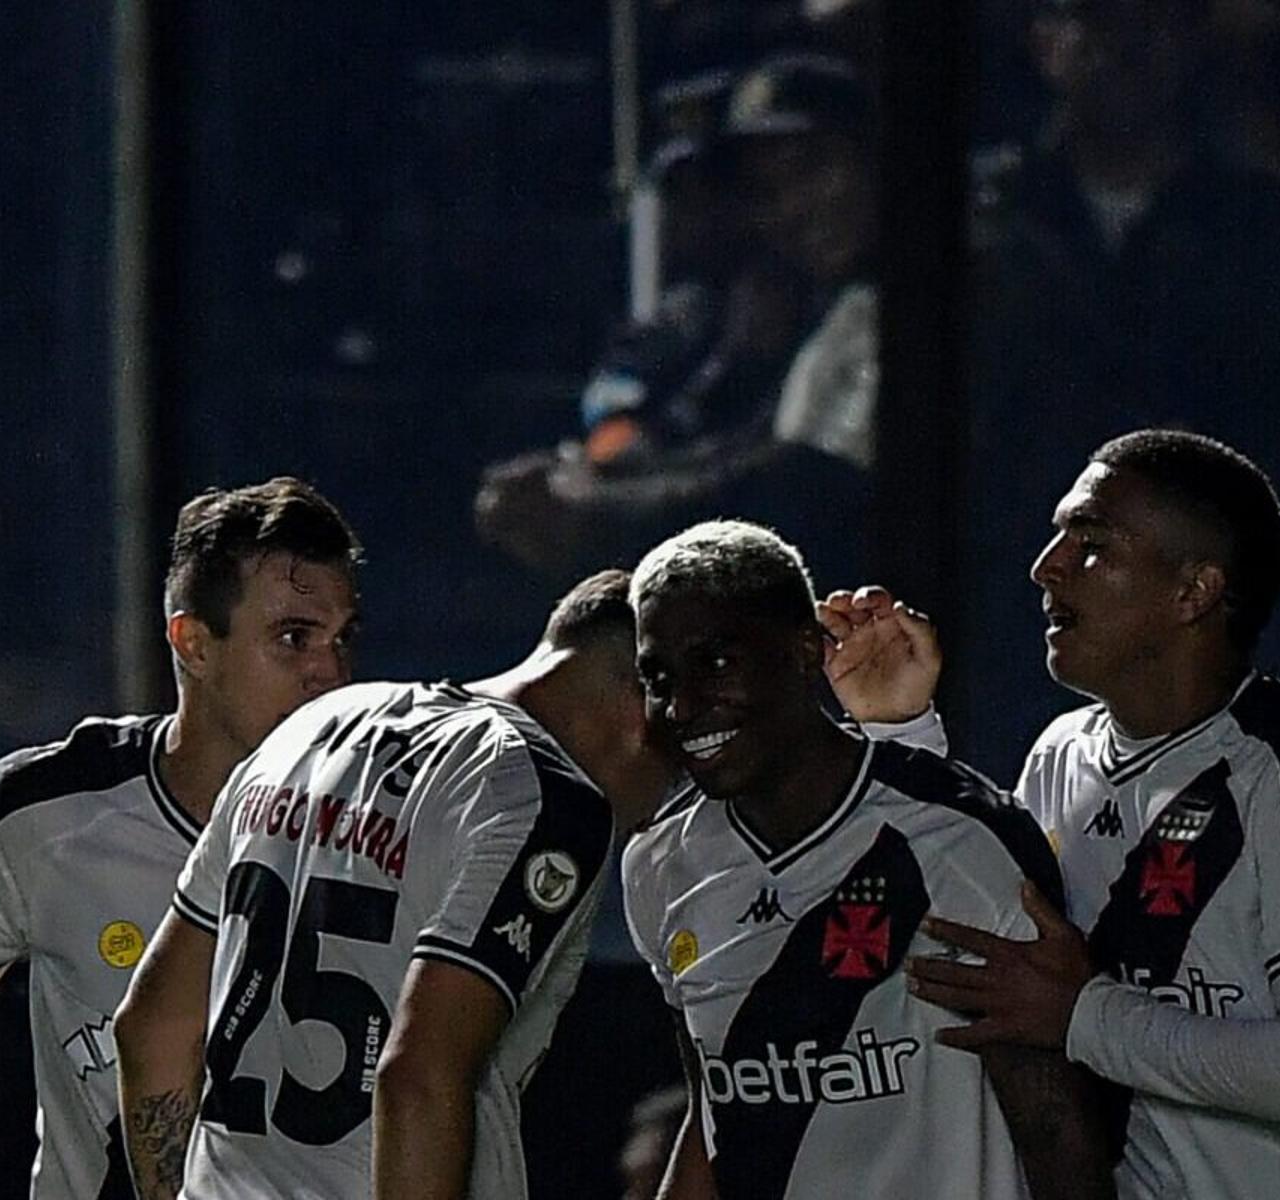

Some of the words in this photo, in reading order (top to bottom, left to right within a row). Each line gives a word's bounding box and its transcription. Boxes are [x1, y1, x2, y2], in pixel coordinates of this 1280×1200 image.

[237, 785, 310, 842] HUGO
[311, 795, 411, 880] MOURA
[200, 862, 399, 1146] 25
[363, 1014, 382, 1066] SCORE
[695, 1028, 919, 1104] betfair
